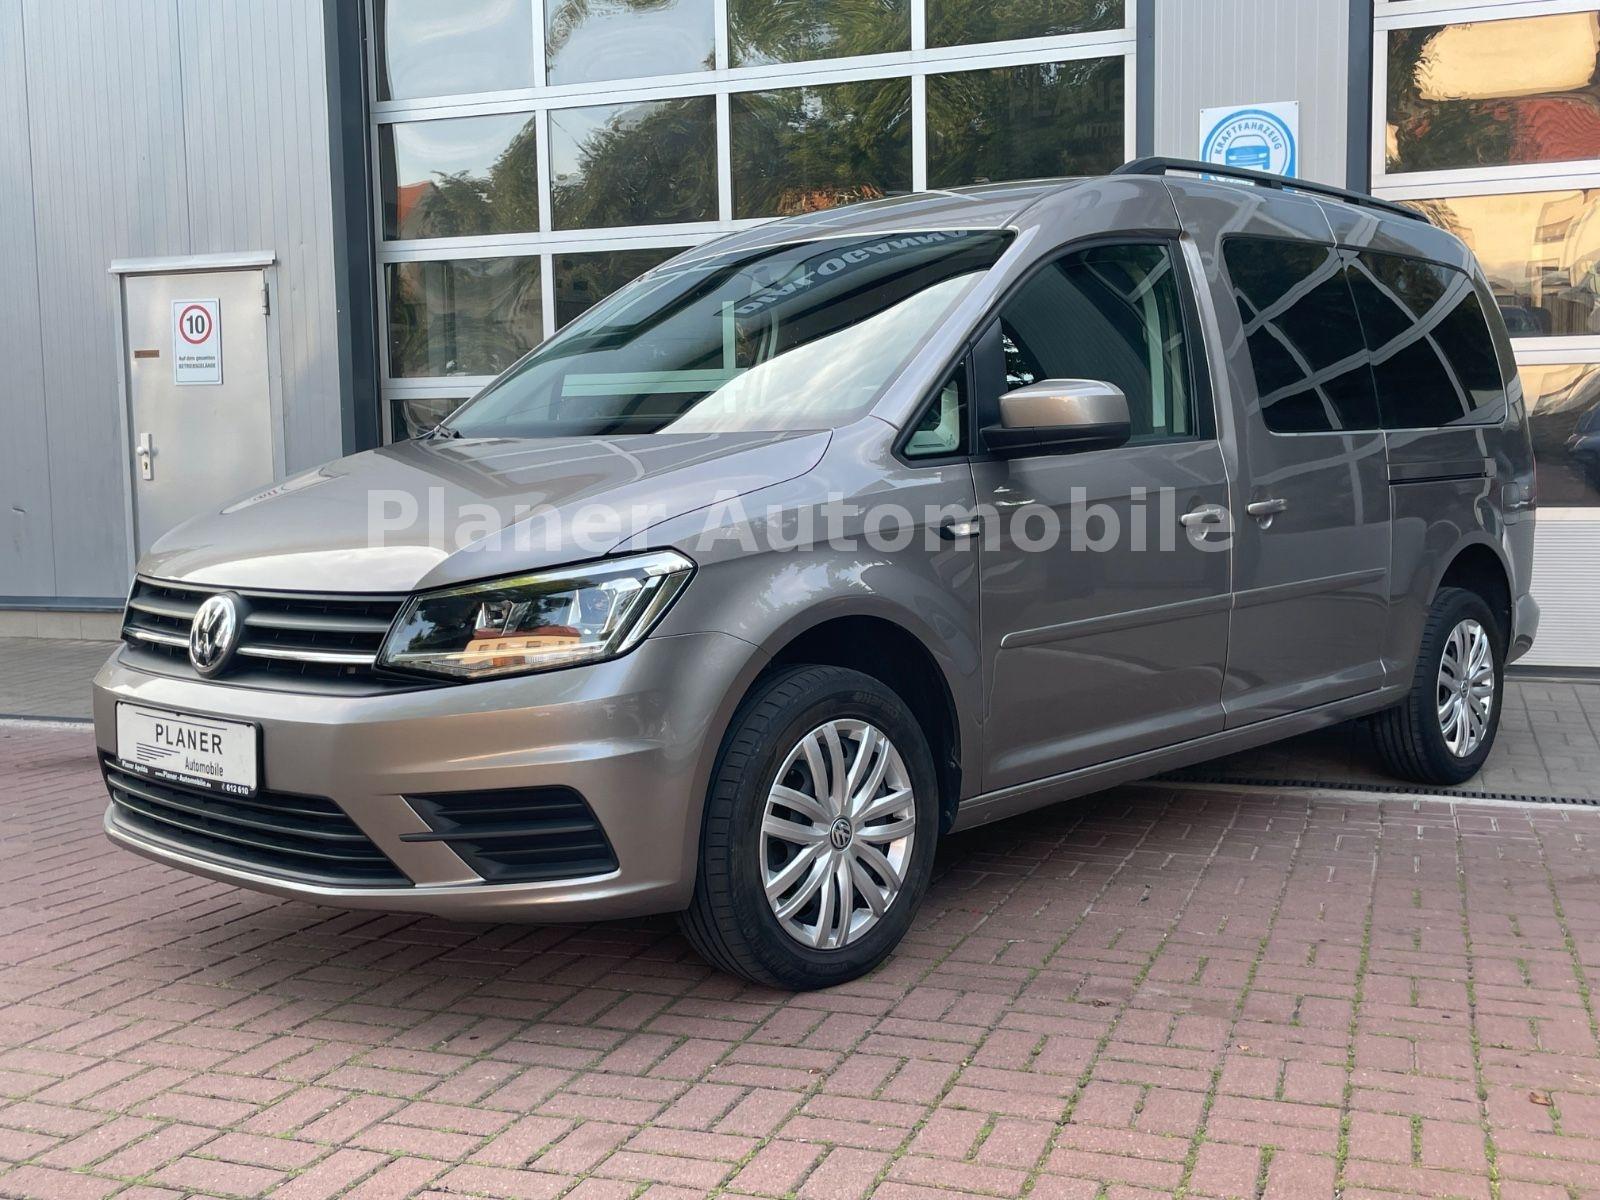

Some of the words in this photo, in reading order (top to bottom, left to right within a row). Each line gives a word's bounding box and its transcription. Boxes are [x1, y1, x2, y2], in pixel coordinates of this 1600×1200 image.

[1214, 121, 1282, 155] KRAFTFAHRZEUG
[186, 315, 205, 334] 10
[155, 723, 223, 755] PLANER
[185, 757, 224, 777] Automobile
[226, 784, 237, 793] 612
[238, 785, 249, 795] 610
